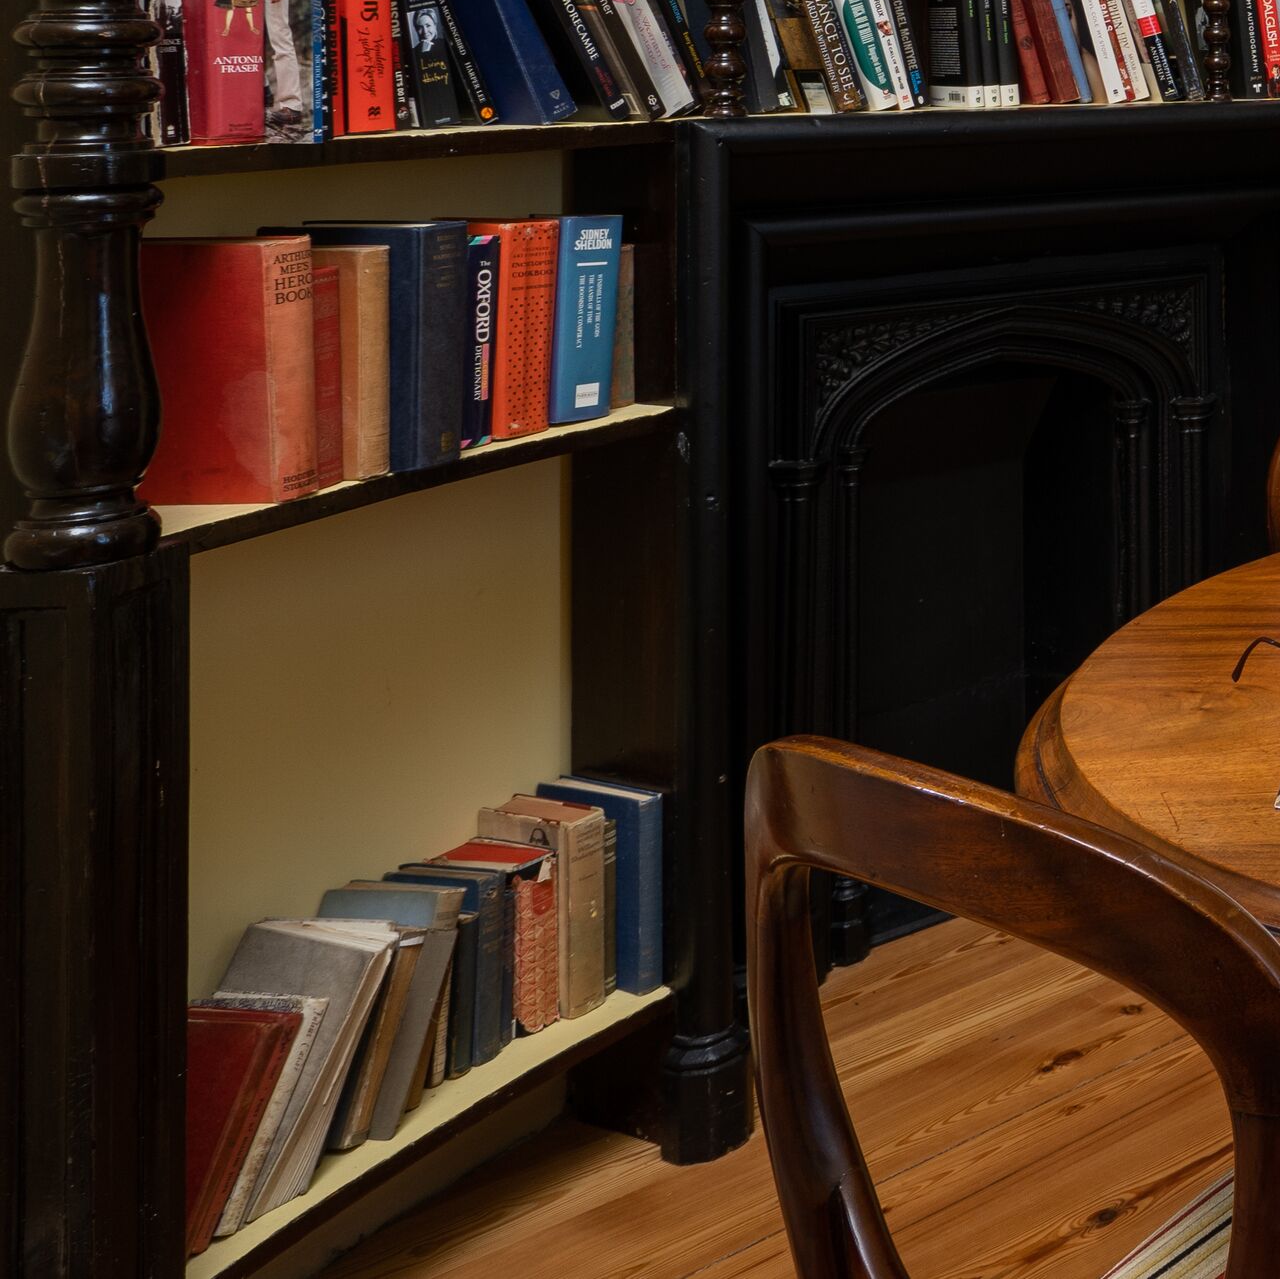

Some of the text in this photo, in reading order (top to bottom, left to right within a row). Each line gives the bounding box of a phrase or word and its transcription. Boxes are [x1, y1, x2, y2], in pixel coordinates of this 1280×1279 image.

[1246, 0, 1251, 9] MY
[1247, 11, 1260, 73] AUTOBIOGRAPHY
[213, 56, 264, 64] ANTONIA
[831, 43, 846, 65] TO
[220, 64, 259, 73] FRASER
[838, 65, 854, 91] SEE
[580, 229, 609, 241] SIDNEY
[574, 239, 612, 251] SHELDON
[473, 260, 492, 401] The OXFORD DICTIONARY
